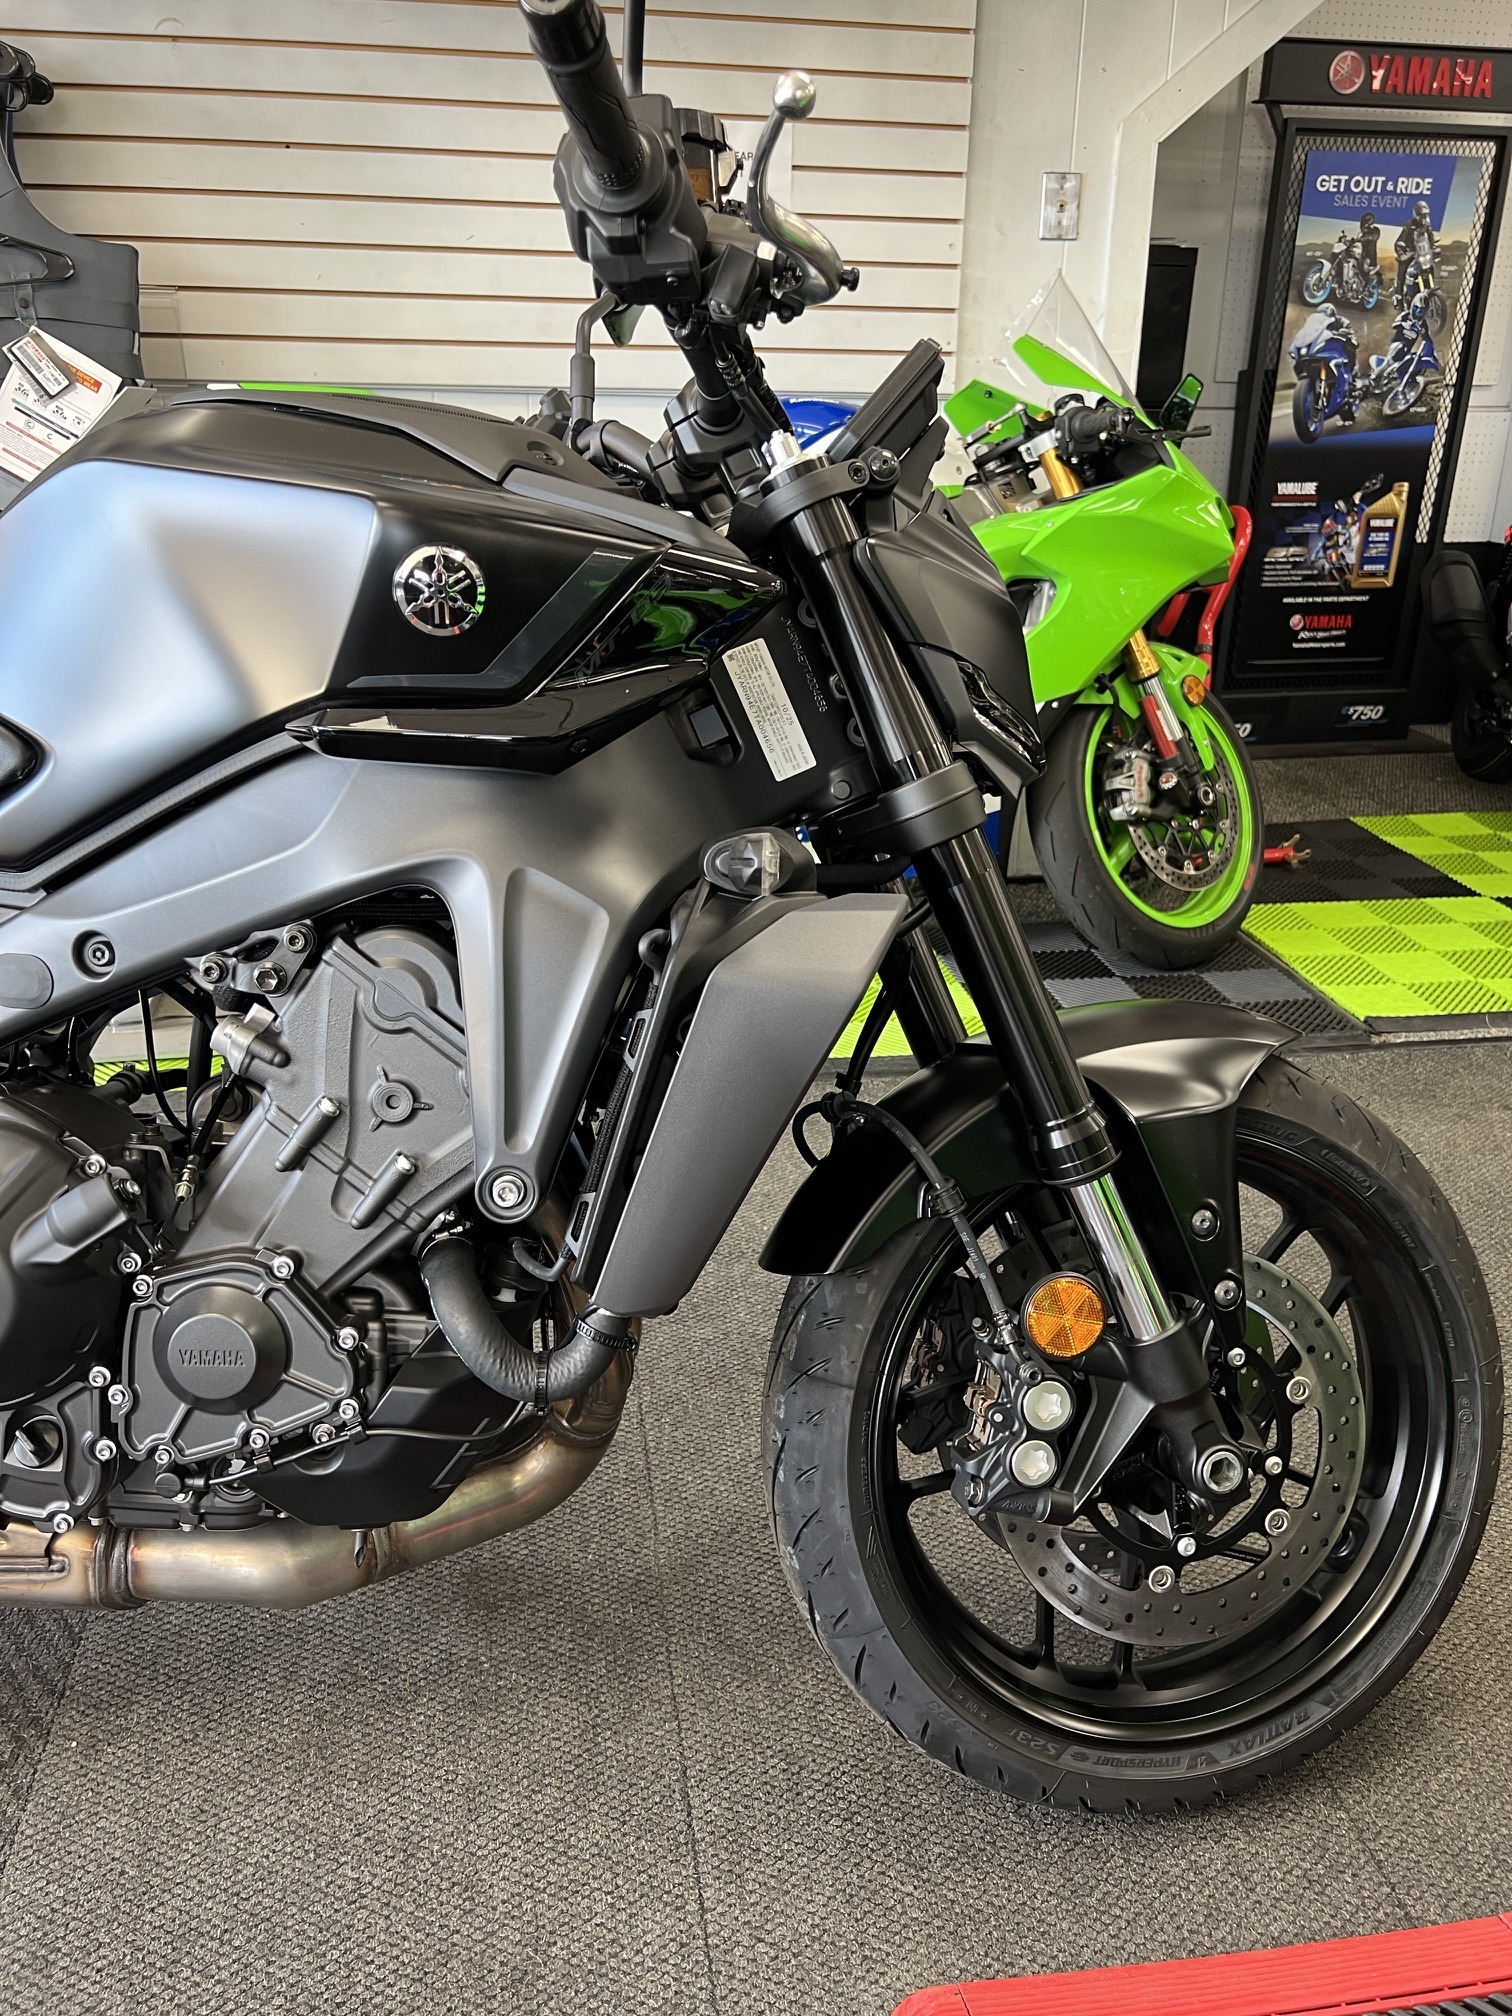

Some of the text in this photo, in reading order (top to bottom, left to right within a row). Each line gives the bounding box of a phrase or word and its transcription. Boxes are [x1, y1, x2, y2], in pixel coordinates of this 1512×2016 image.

[1369, 54, 1493, 99] YAMAHA
[1316, 175, 1434, 195] GET OUT & RIDE
[1333, 194, 1409, 209] SALES EVENT
[1304, 615, 1352, 629] YAMAHA
[178, 1349, 246, 1368] YAMAHA
[1092, 1755, 1181, 1768] HYPERSPORT
